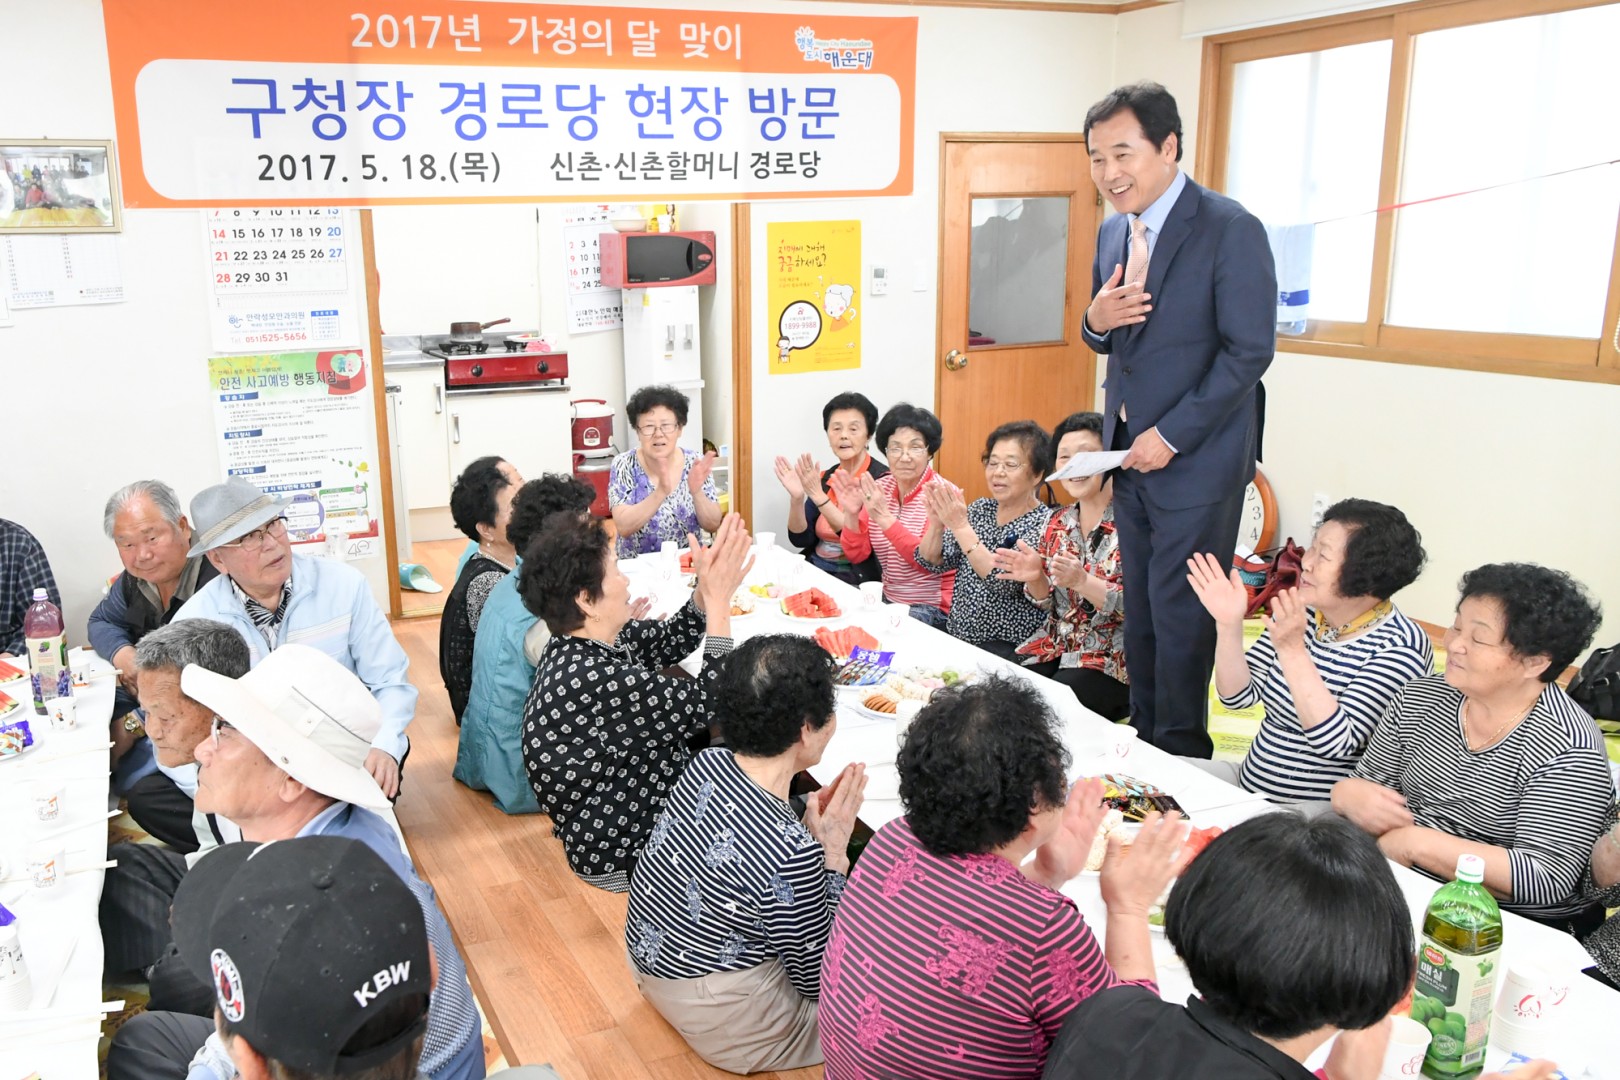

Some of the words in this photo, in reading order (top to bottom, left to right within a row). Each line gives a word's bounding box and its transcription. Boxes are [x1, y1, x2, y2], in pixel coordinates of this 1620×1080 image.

[351, 13, 482, 52] 2017년
[507, 16, 613, 56] 가정의
[627, 20, 659, 57] 달
[679, 22, 743, 60] 맞이
[824, 51, 872, 68] 해운대
[225, 78, 414, 141] 구청장
[439, 82, 606, 142] 경로당
[625, 82, 730, 141] 현장
[748, 88, 840, 142] 방문
[258, 154, 349, 183] 2017.
[361, 154, 389, 182] 5.
[401, 152, 501, 184] 18.(목)
[550, 150, 740, 182] 신촌·신촌할머니
[748, 150, 822, 180] 경로당
[212, 229, 226, 239] 14
[232, 228, 246, 238] 15
[251, 228, 265, 238] 16
[271, 228, 284, 238] 17
[290, 228, 304, 237] 18
[309, 227, 322, 237] 19
[327, 226, 342, 237] 20
[215, 251, 228, 261] 21
[233, 251, 248, 261] 22
[253, 250, 268, 260] 23
[272, 250, 287, 260] 24
[291, 250, 306, 259] 25
[310, 249, 324, 258] 26
[329, 248, 342, 258] 27
[778, 253, 827, 272] 궁금하세요?
[216, 273, 231, 283] 28
[235, 273, 250, 283] 29
[255, 272, 270, 282] 30
[275, 272, 288, 282] 31
[219, 378, 242, 392] 안전
[246, 376, 290, 388] 사고예방
[294, 372, 338, 386] 행동지침
[1246, 486, 1256, 502] 2
[1252, 506, 1262, 520] 3
[1250, 527, 1259, 541] 4
[1420, 962, 1443, 982] 매실
[353, 960, 412, 1008] KBW
